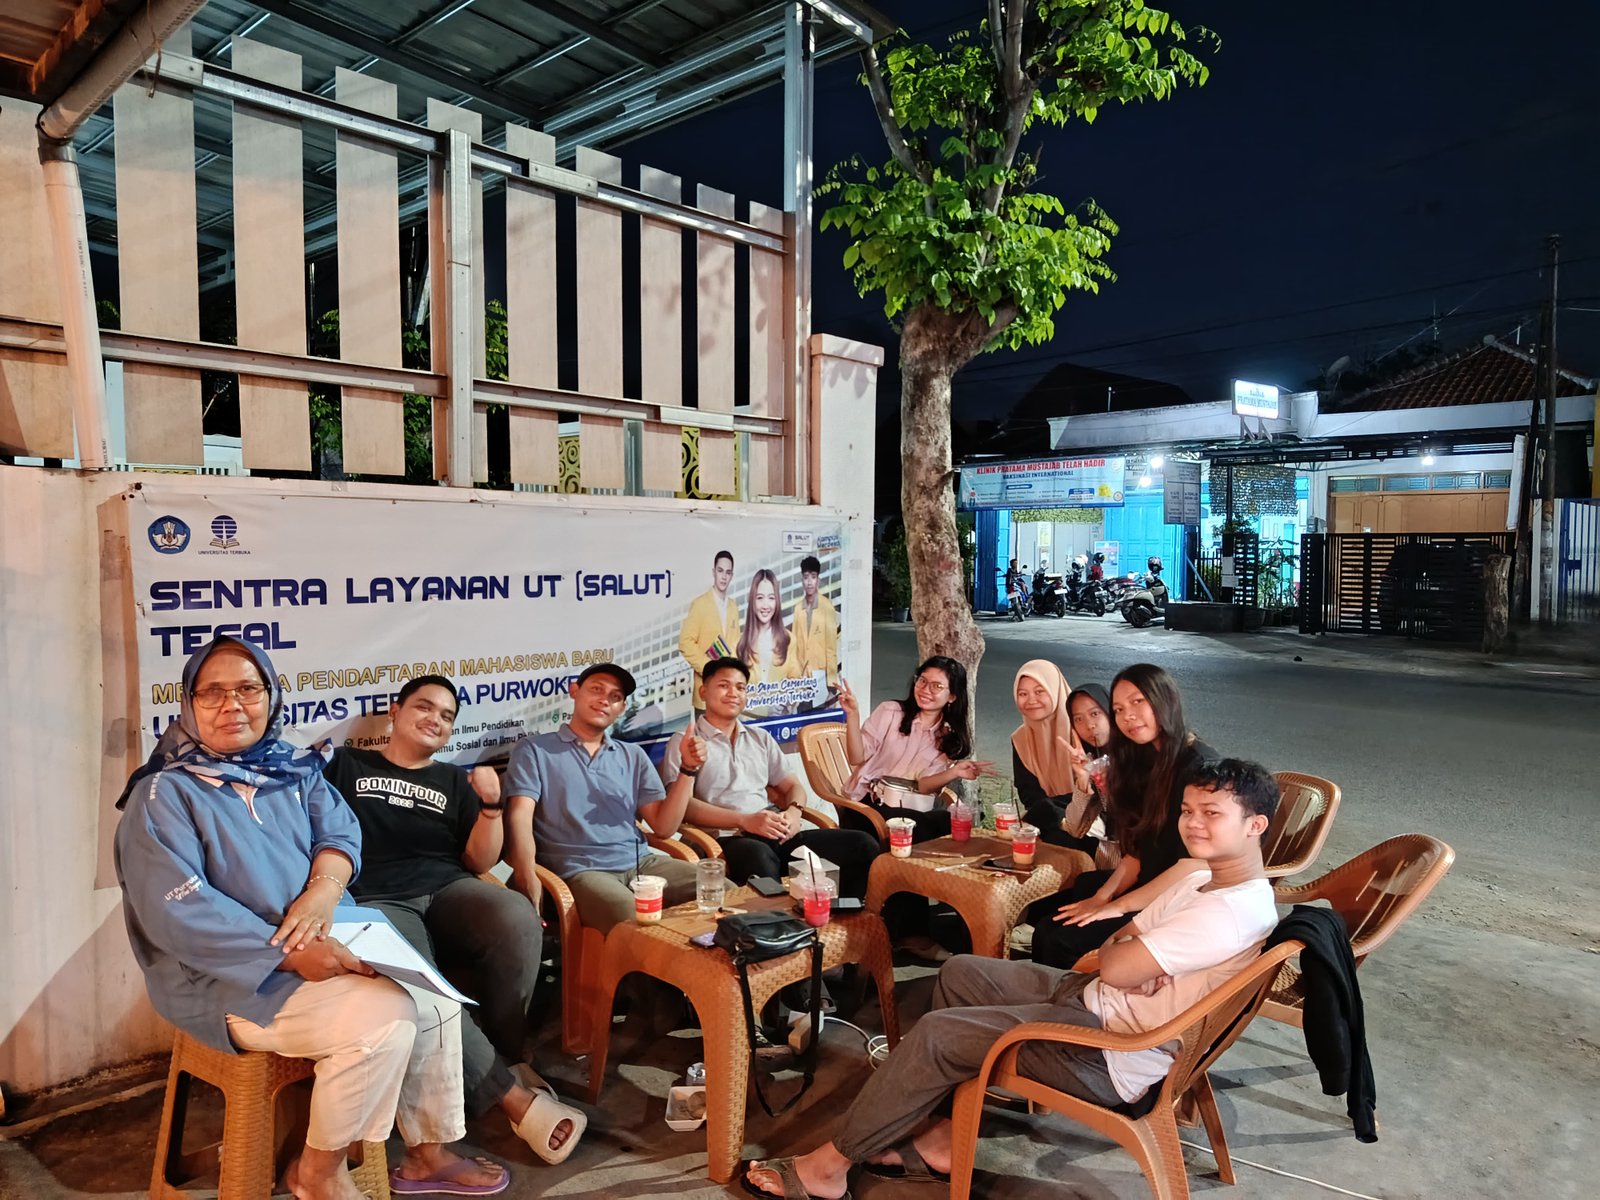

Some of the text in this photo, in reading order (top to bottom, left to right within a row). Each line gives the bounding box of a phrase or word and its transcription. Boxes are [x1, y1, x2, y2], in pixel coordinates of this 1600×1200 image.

[976, 459, 1105, 474] KLINIK PRATAMA MUSTAJAB TELAH HADIR
[150, 578, 328, 611] SENTRA
[346, 575, 509, 604] LAYANAN
[524, 575, 562, 598] UT
[297, 661, 455, 692] PENDAFTARAN
[460, 652, 568, 676] MAHASISWA
[571, 648, 614, 667] BARU
[475, 675, 581, 705] PURWOK
[757, 682, 779, 693] Depan
[781, 678, 818, 690] Cemerlang
[357, 735, 392, 748] Fakulta
[462, 725, 480, 735] Ilmu
[481, 719, 524, 732] Pendidikan
[455, 738, 482, 751] Sosial
[482, 737, 498, 748] dan
[356, 777, 447, 810] COMINFOUR
[388, 795, 414, 808] 2022
